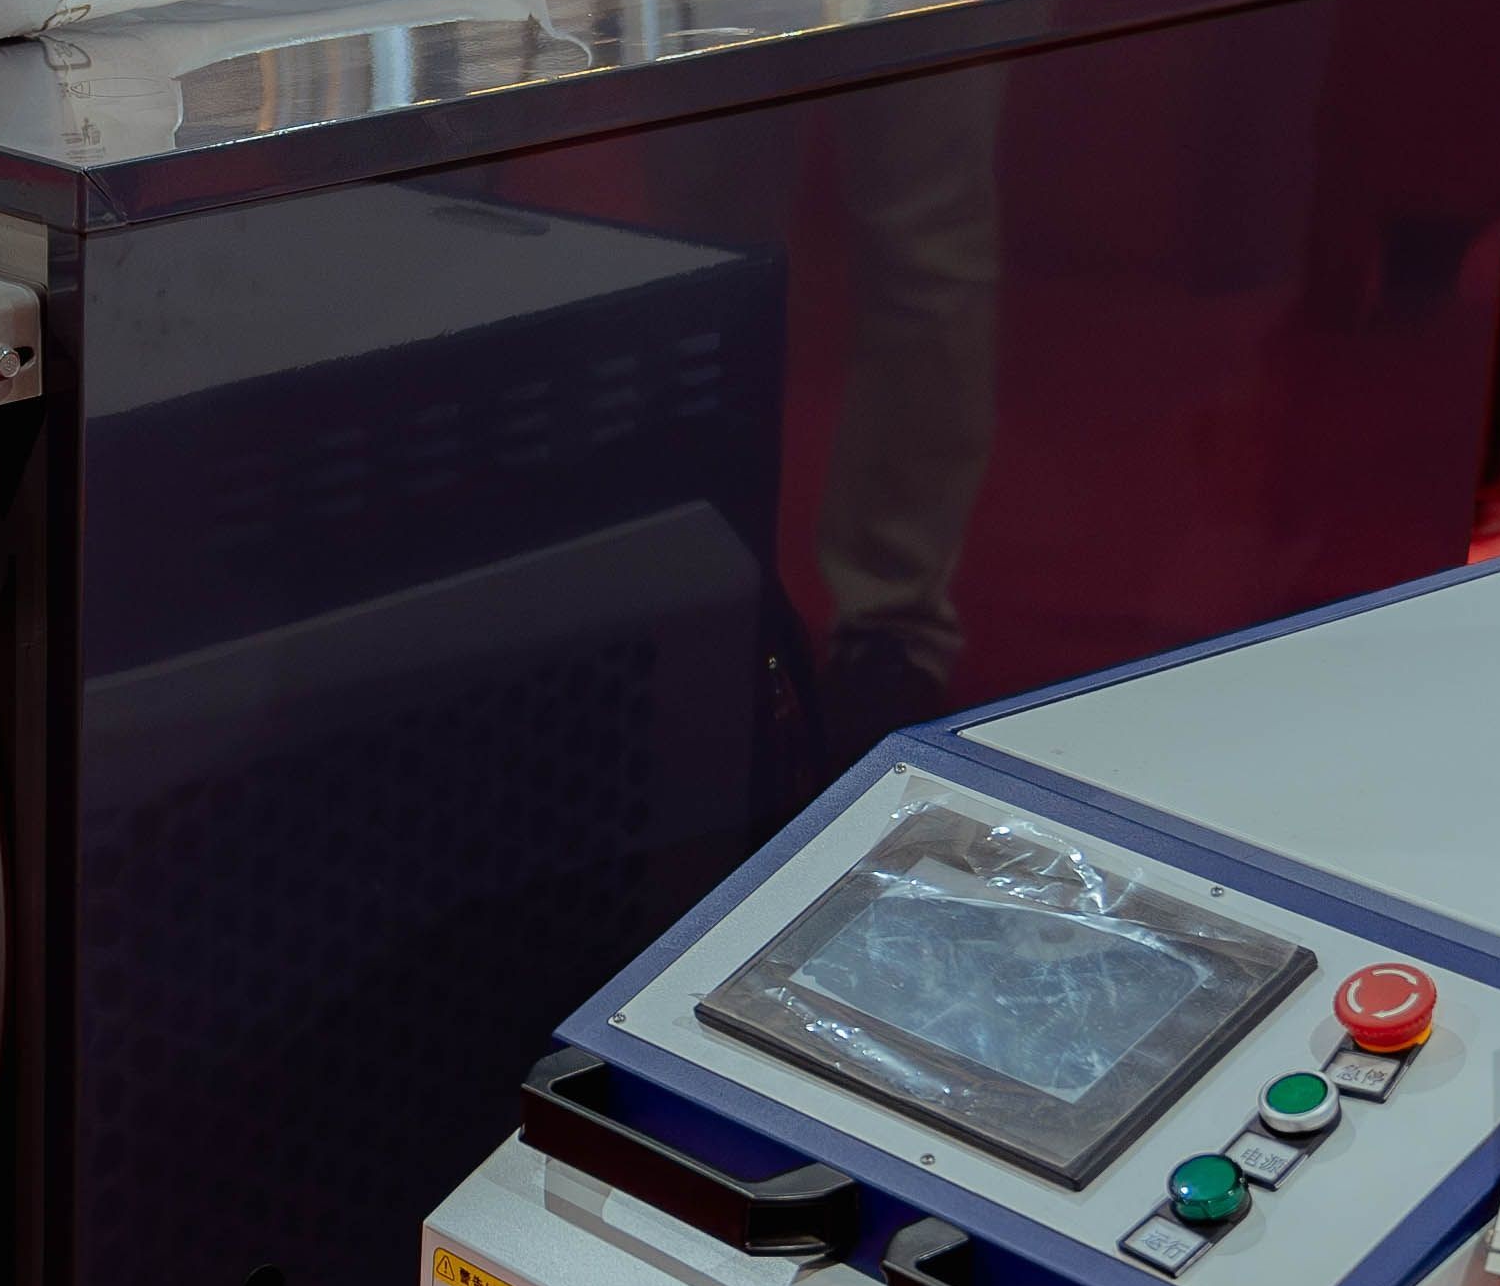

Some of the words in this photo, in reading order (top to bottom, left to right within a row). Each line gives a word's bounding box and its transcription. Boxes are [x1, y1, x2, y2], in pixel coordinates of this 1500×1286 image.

[1337, 1064, 1386, 1087] 急停
[1240, 1146, 1290, 1175] 电源
[1143, 1231, 1190, 1260] 运行
